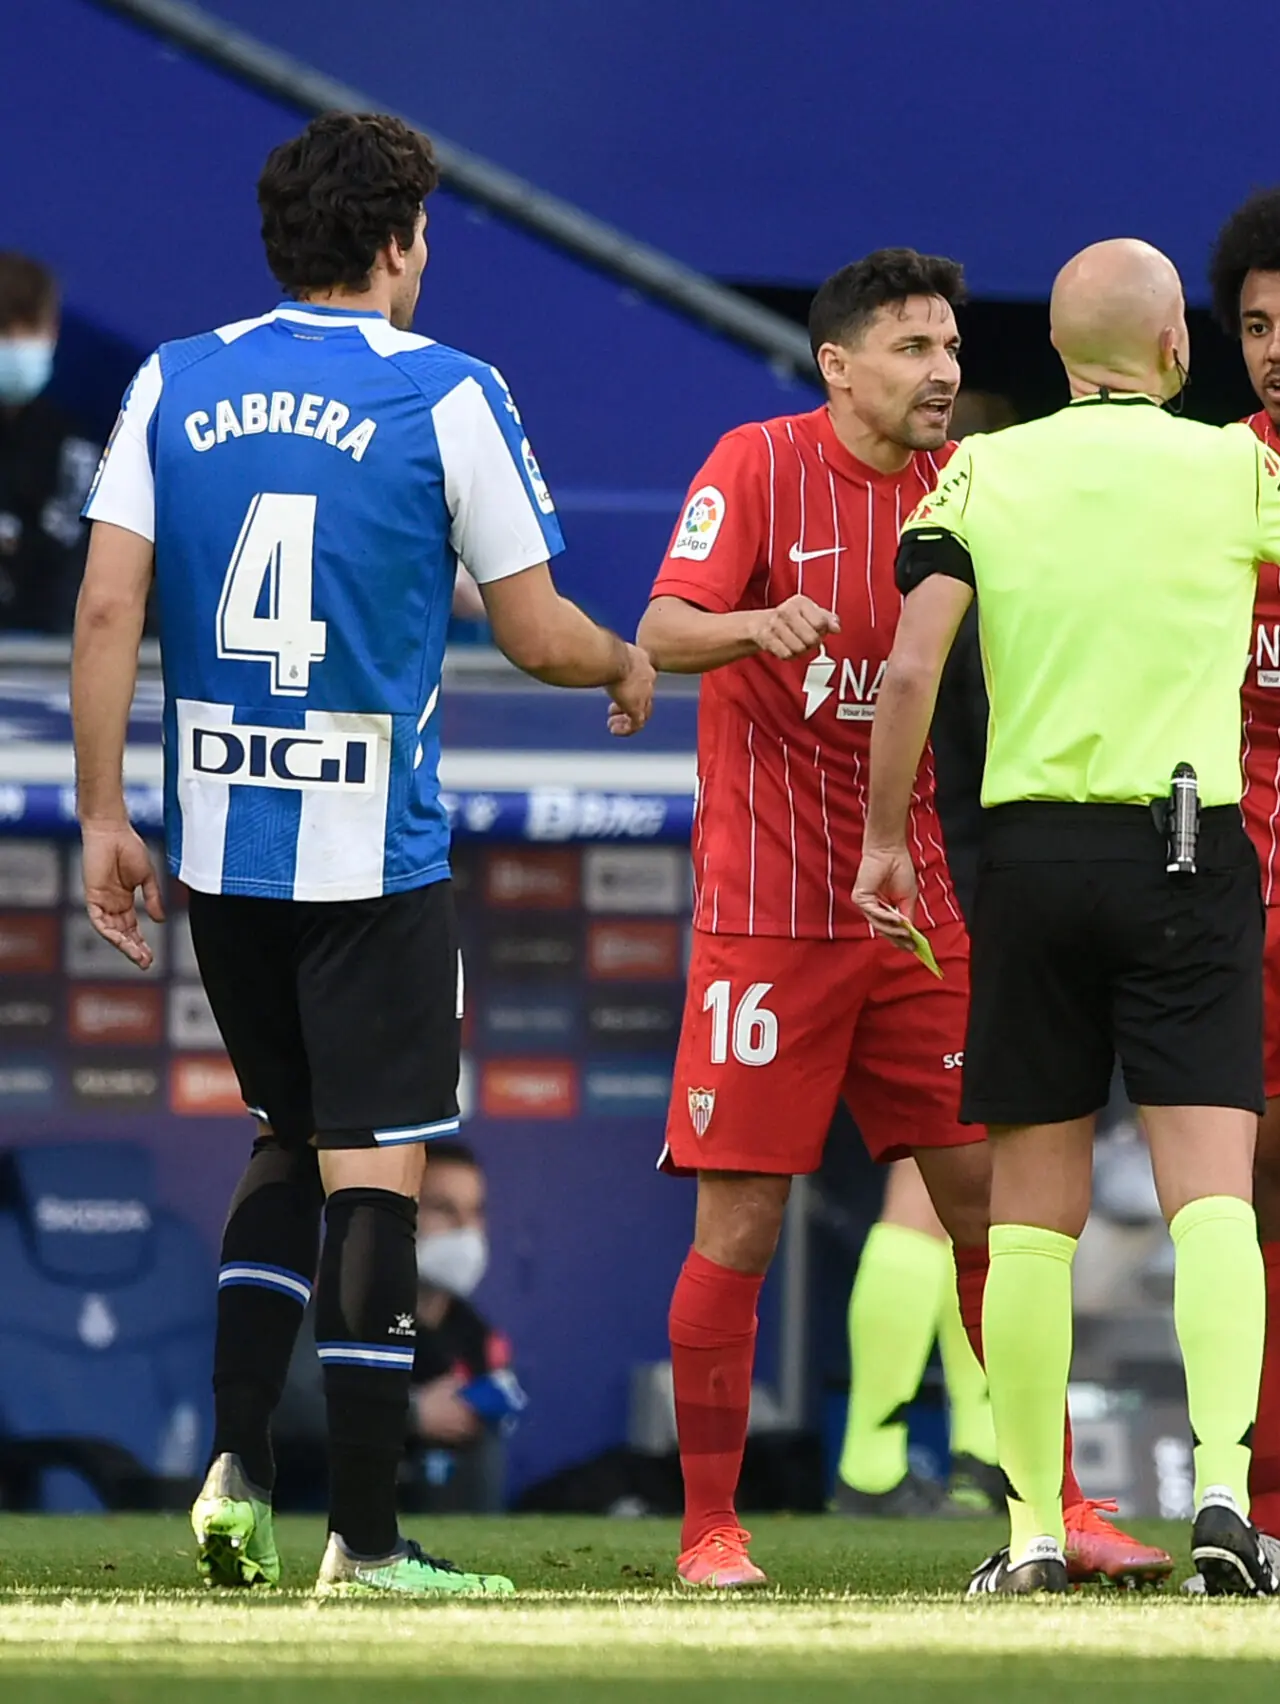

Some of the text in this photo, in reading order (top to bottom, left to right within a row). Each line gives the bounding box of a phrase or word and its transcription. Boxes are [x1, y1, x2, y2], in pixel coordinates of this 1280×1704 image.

[184, 391, 377, 462] CABRERA
[216, 492, 327, 697] 4
[838, 657, 889, 702] NA
[193, 728, 367, 784] DIGI
[703, 980, 779, 1067] 16
